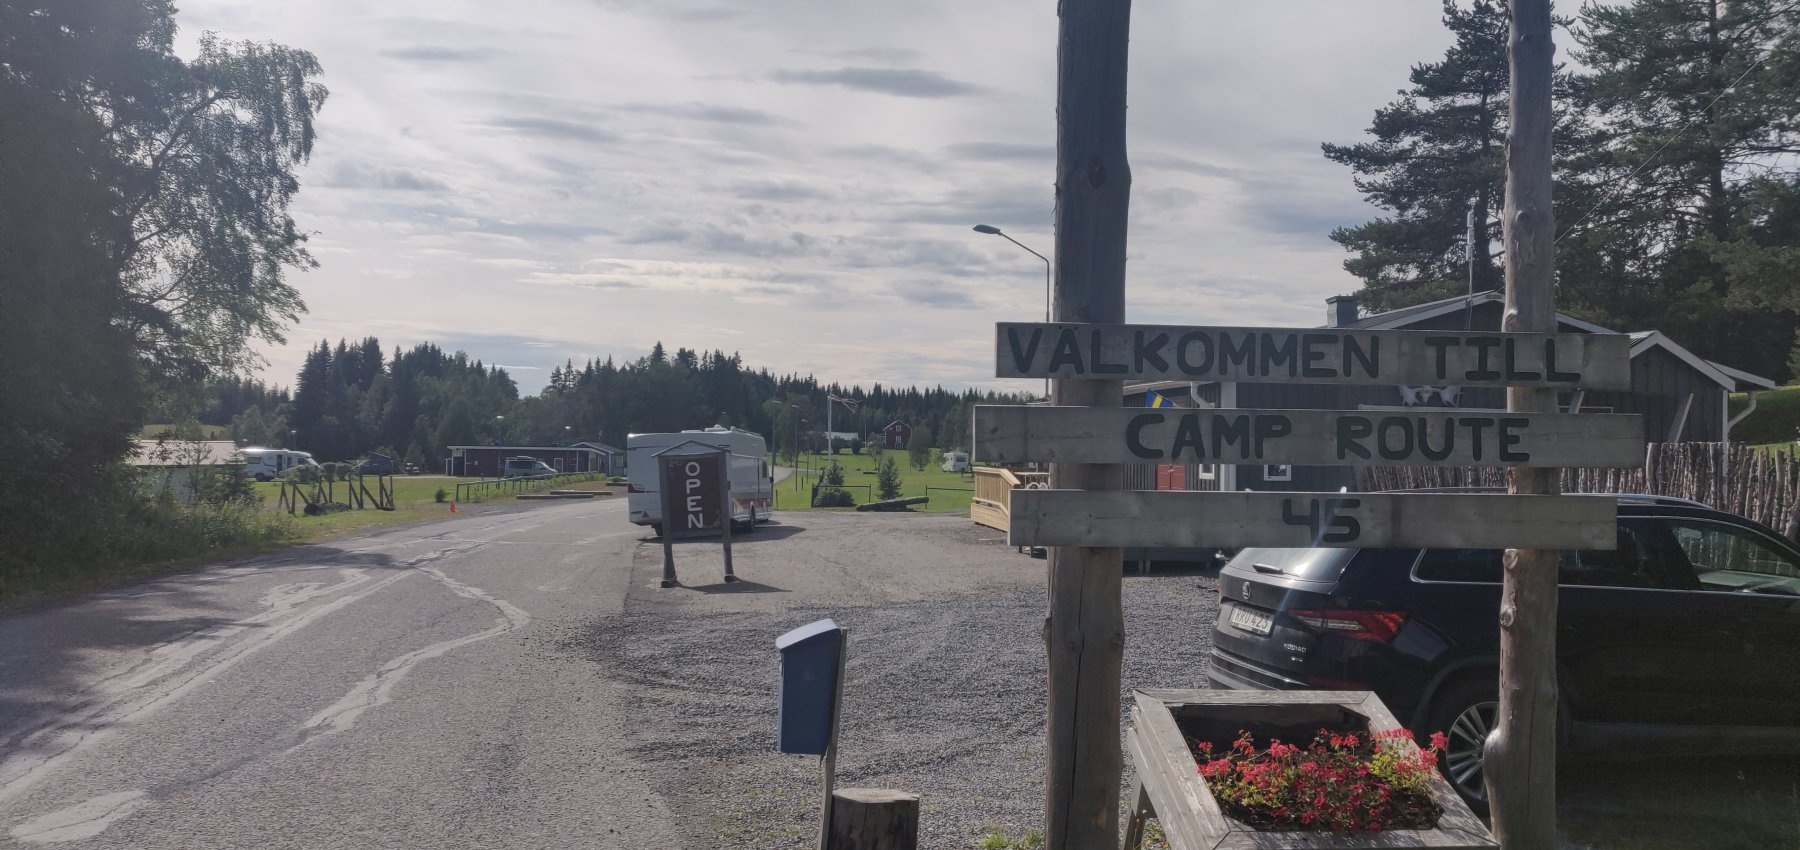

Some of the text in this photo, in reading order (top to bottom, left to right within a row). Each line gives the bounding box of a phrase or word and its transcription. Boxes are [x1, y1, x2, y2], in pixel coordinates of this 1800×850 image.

[1007, 326, 1581, 382] VÄLKOMMEN TILL
[1126, 413, 1530, 462] CAMP ROUTE
[685, 461, 704, 529] OPEN
[1282, 498, 1361, 543] 45
